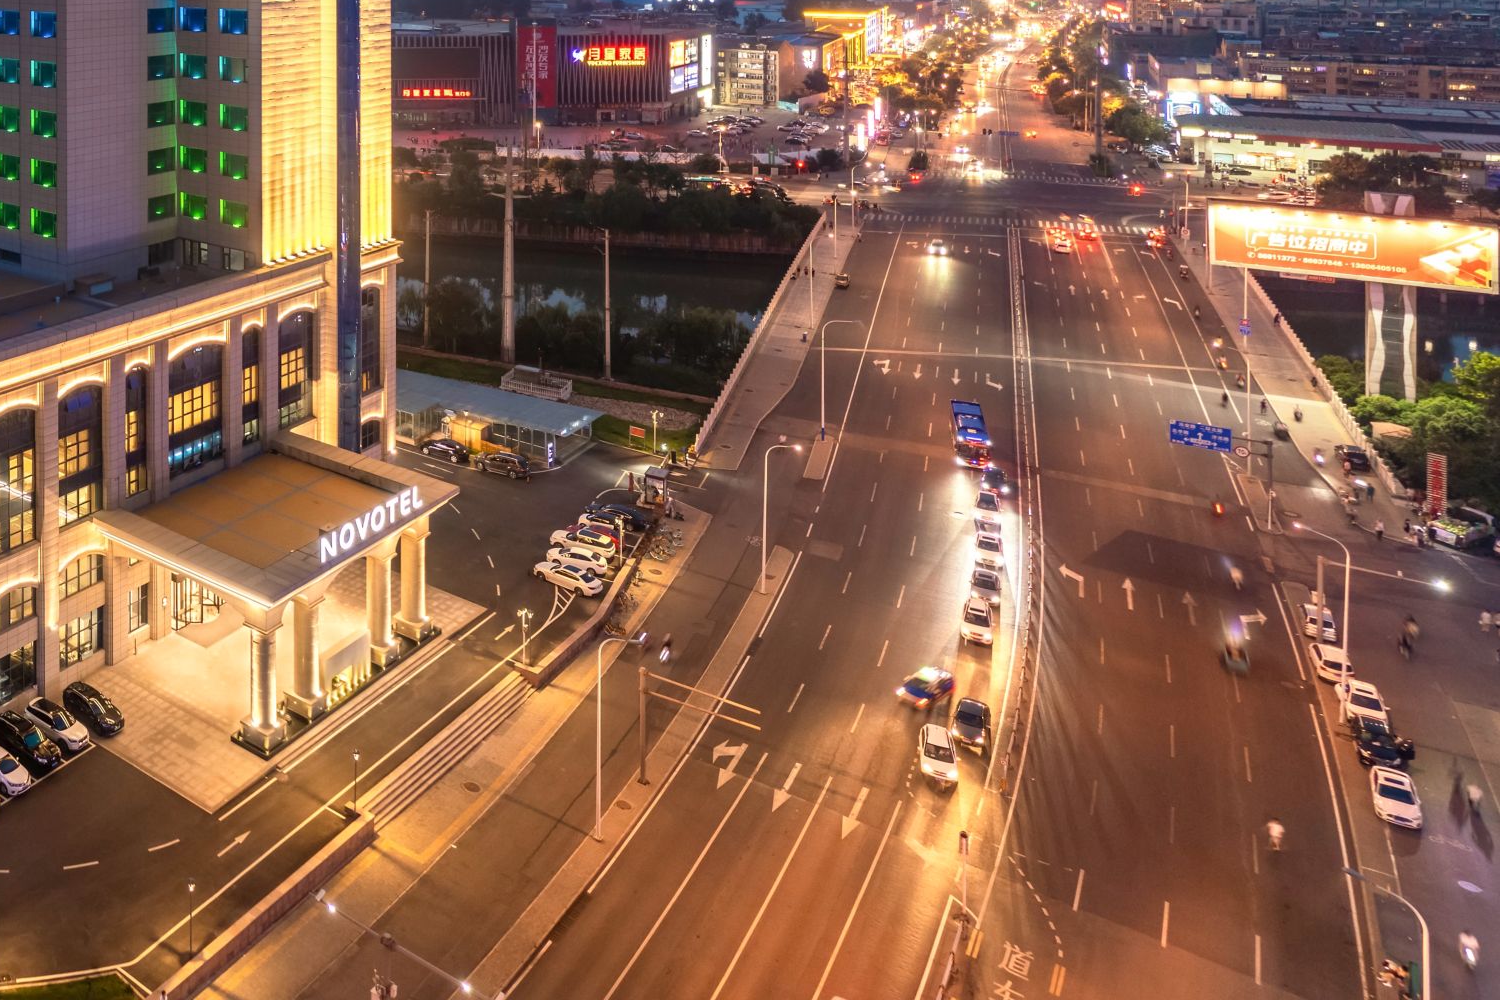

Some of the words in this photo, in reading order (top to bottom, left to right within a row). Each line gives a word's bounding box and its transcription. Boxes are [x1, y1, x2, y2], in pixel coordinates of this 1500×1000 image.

[588, 47, 646, 60] 月星家居
[1251, 231, 1368, 255] 广告位招商中
[320, 485, 423, 564] NOVOTEL
